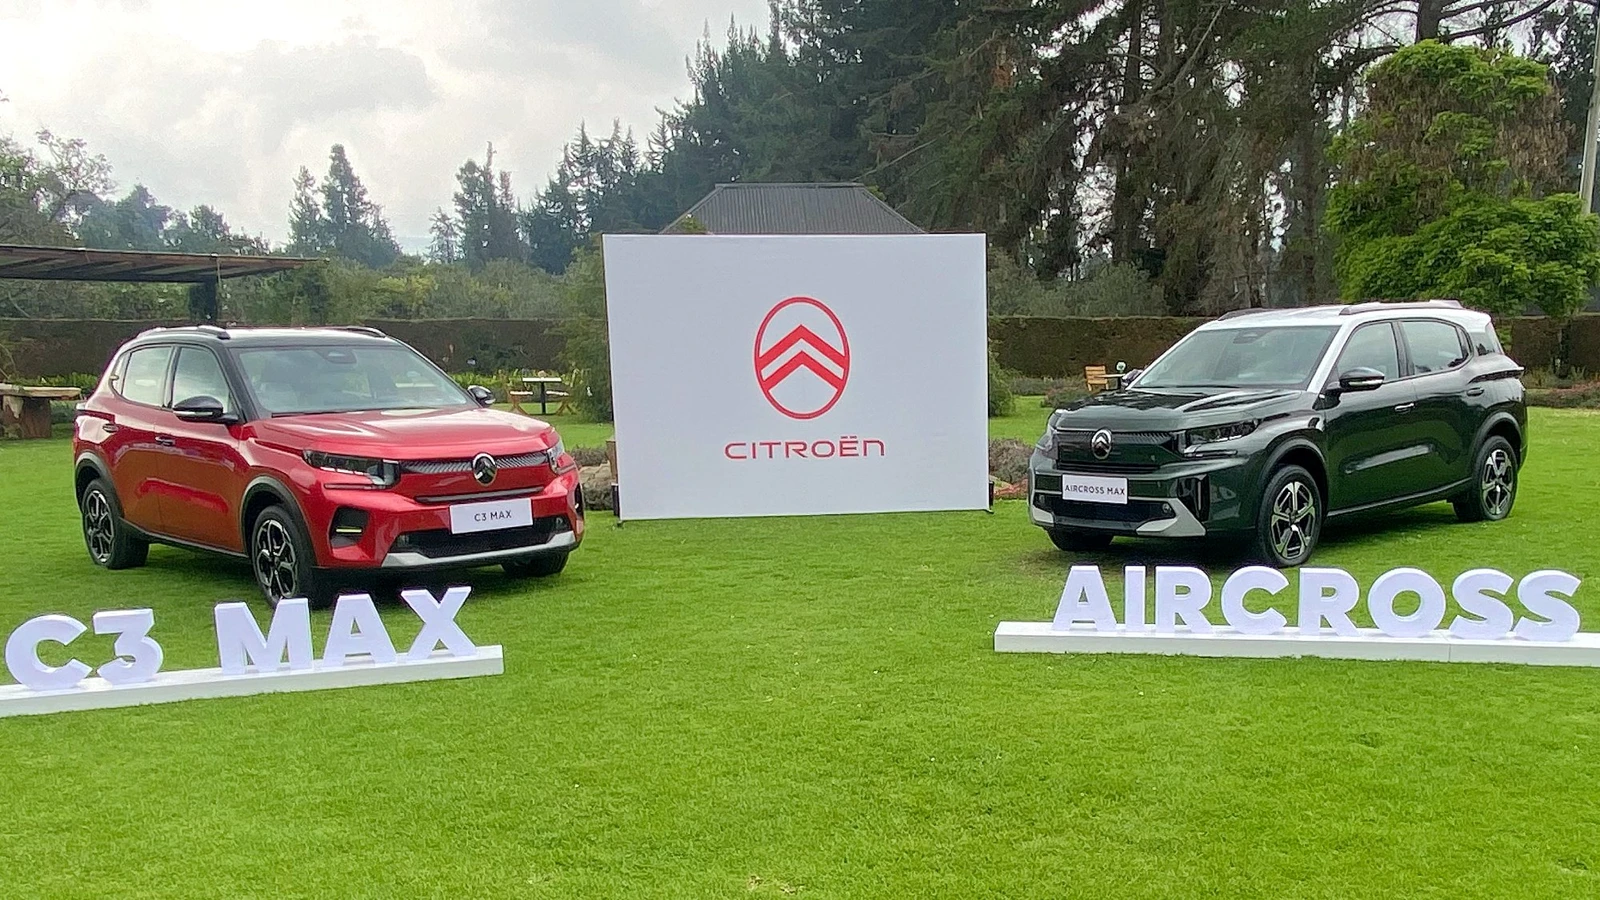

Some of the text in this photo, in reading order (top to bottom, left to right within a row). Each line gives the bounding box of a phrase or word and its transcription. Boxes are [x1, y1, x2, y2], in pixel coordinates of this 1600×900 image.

[1065, 484, 1125, 496] AIRCROSS MAX
[474, 509, 512, 522] C3 MAX
[1051, 565, 1583, 642] AIRCROSS
[5, 586, 477, 690] C3 MAX
